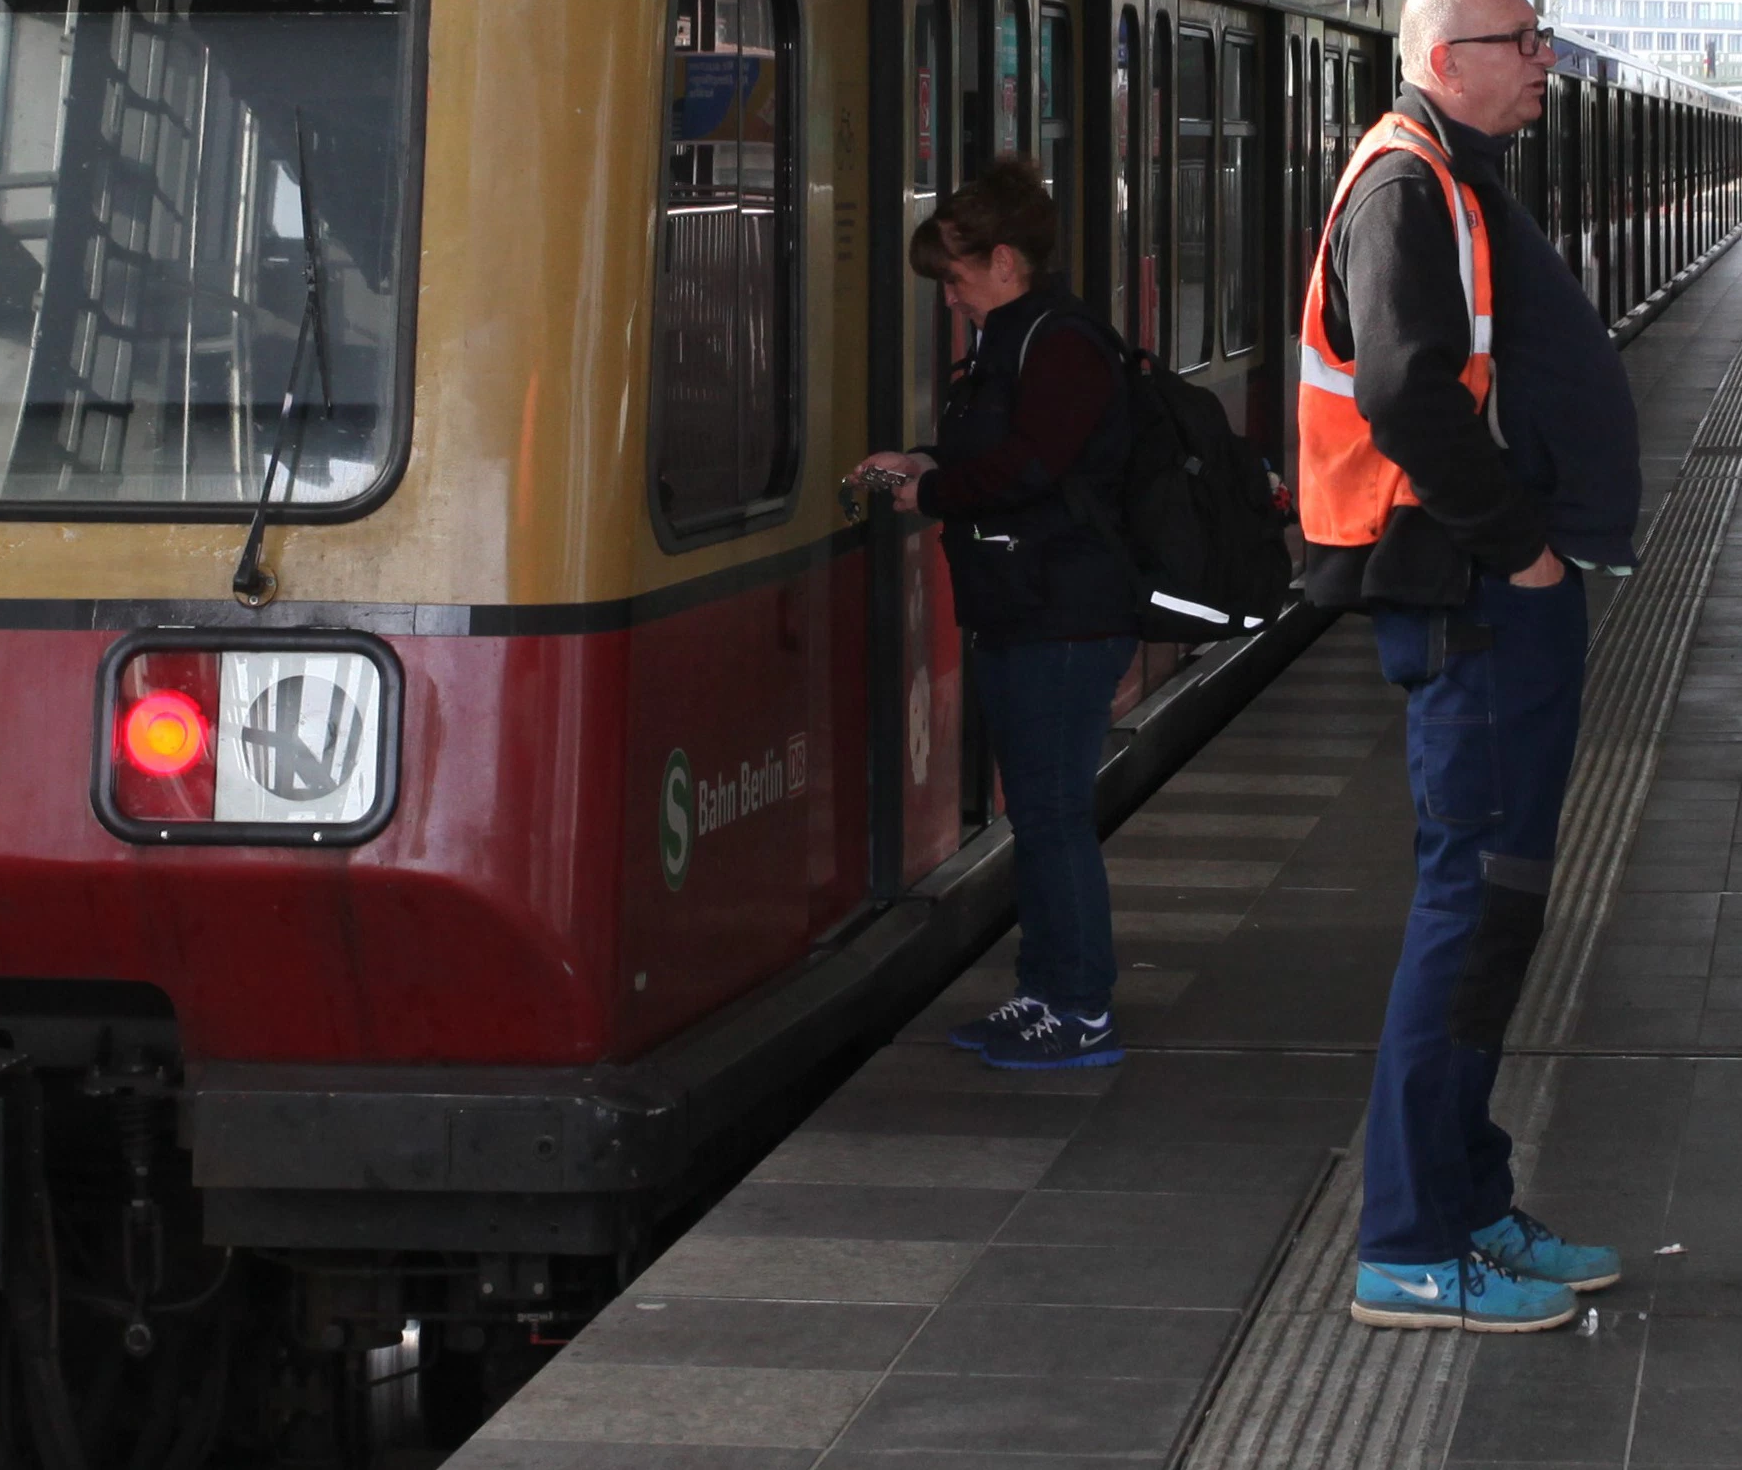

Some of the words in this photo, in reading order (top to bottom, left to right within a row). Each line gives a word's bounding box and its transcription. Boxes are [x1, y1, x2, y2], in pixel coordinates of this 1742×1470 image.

[666, 766, 688, 875] S
[698, 771, 736, 838] Bahn
[741, 749, 783, 817] Berlin
[789, 742, 805, 790] DB
